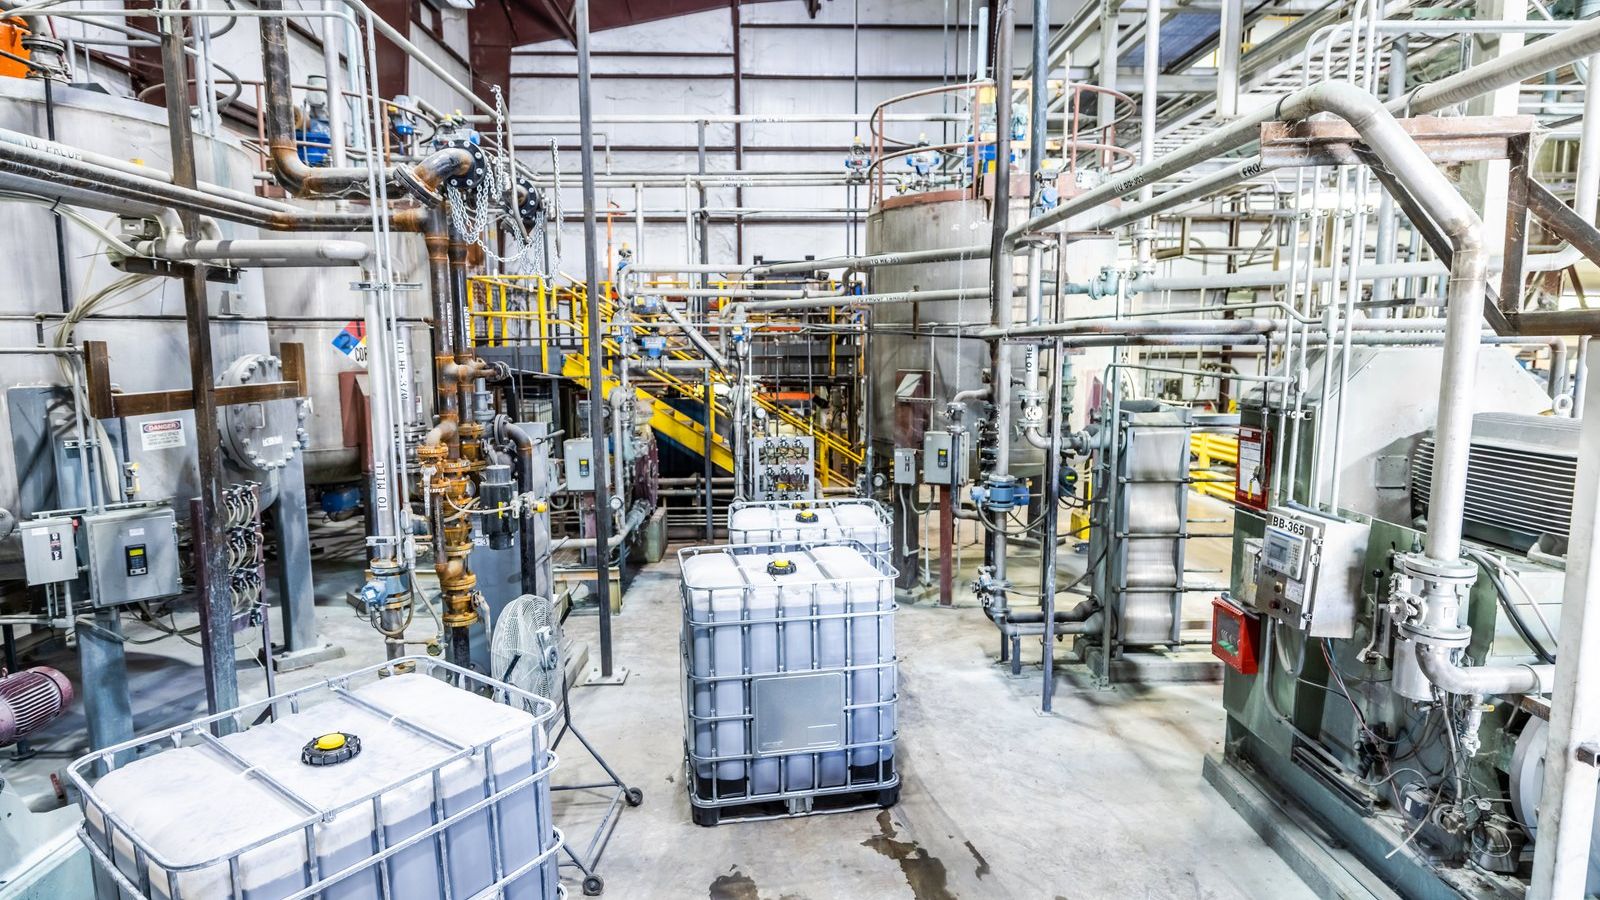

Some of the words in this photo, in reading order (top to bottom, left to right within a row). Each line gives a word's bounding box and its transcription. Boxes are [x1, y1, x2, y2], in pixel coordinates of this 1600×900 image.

[339, 333, 351, 349] 2
[1025, 361, 1033, 373] TO
[148, 423, 178, 432] DANGER
[376, 462, 386, 489] MILL
[377, 496, 387, 509] TO
[1273, 516, 1305, 536] BB-365
